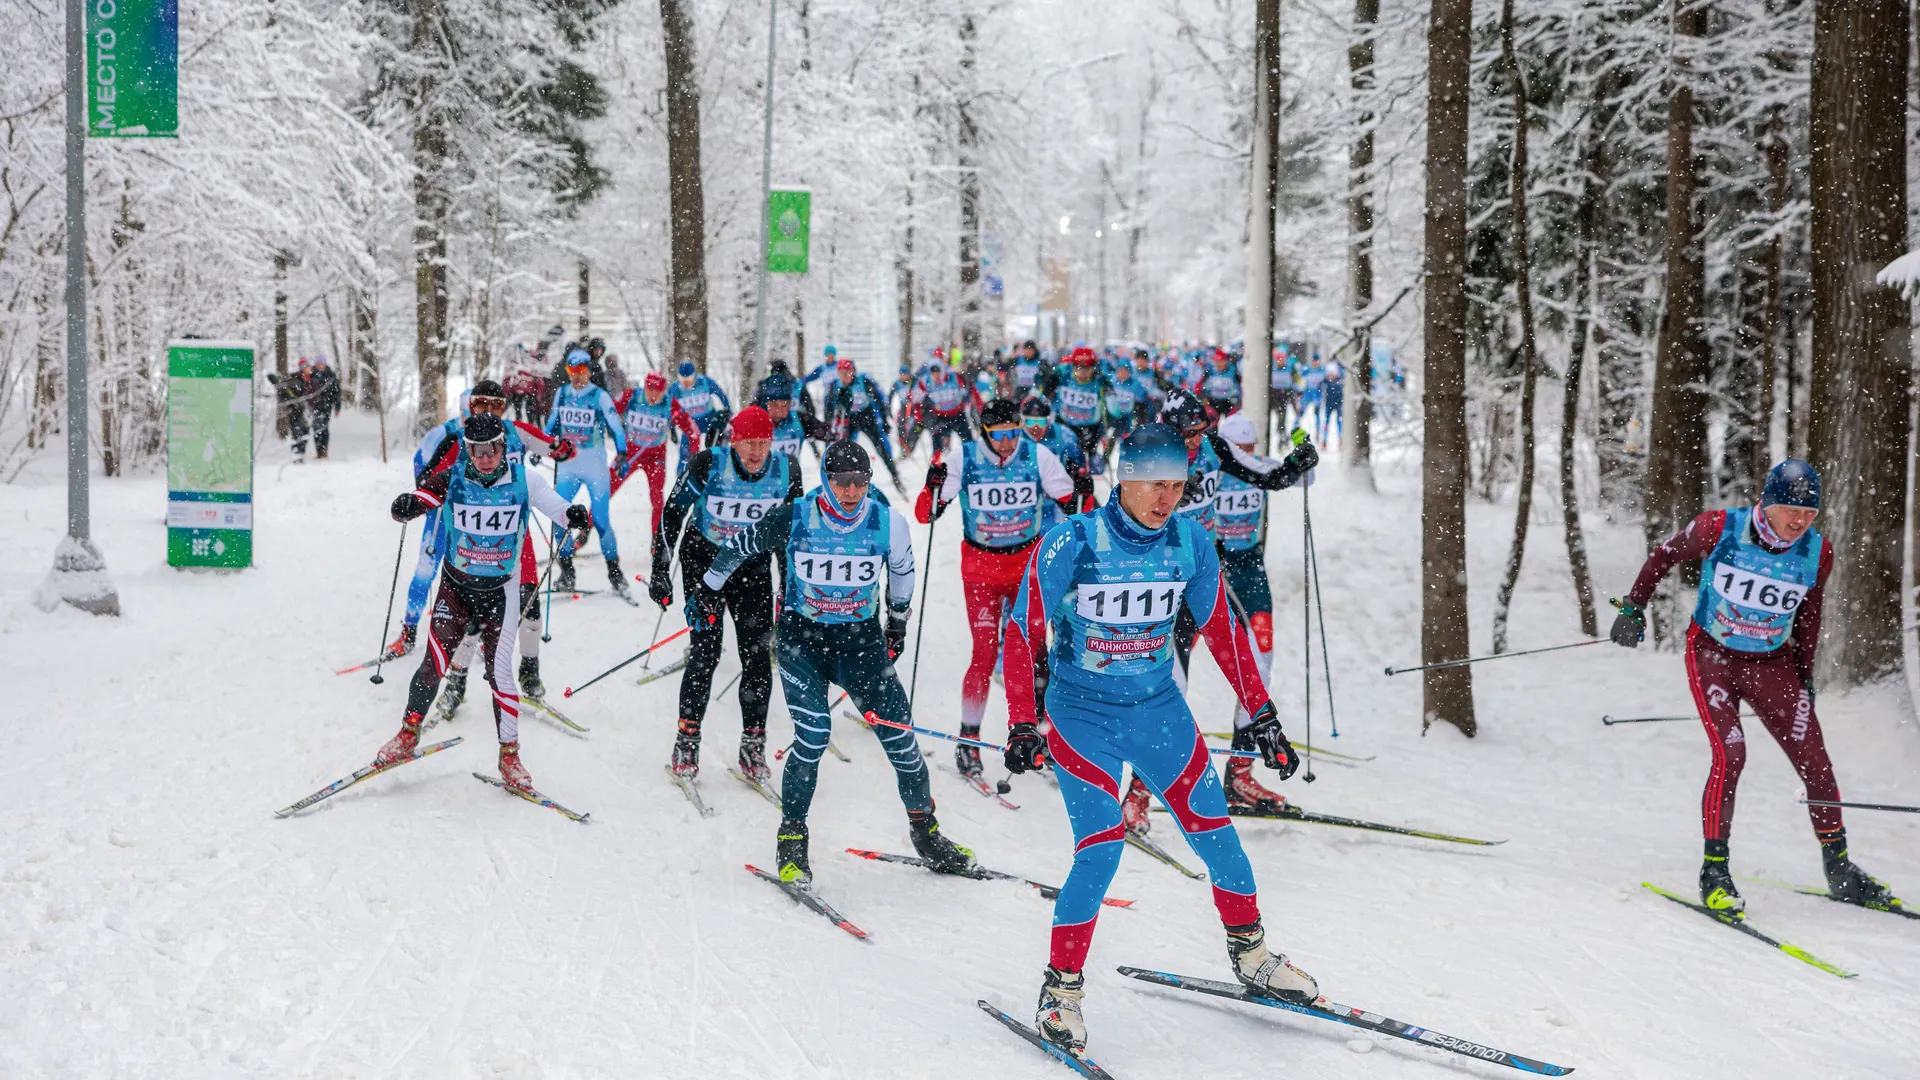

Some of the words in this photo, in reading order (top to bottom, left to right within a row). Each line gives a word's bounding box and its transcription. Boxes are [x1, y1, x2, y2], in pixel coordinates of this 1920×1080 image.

[96, 27, 117, 129] МЕСТО
[560, 409, 592, 425] 1059
[973, 487, 1033, 507] 1082
[1215, 492, 1260, 511] 1143
[457, 509, 517, 531] 1147
[713, 500, 778, 520] 116
[800, 558, 876, 582] 1113
[1720, 572, 1800, 611] 1166
[1088, 588, 1175, 618] 1111
[1090, 633, 1166, 652] МАНЖОСОВСКАЯ
[1434, 1033, 1506, 1062] salomon
